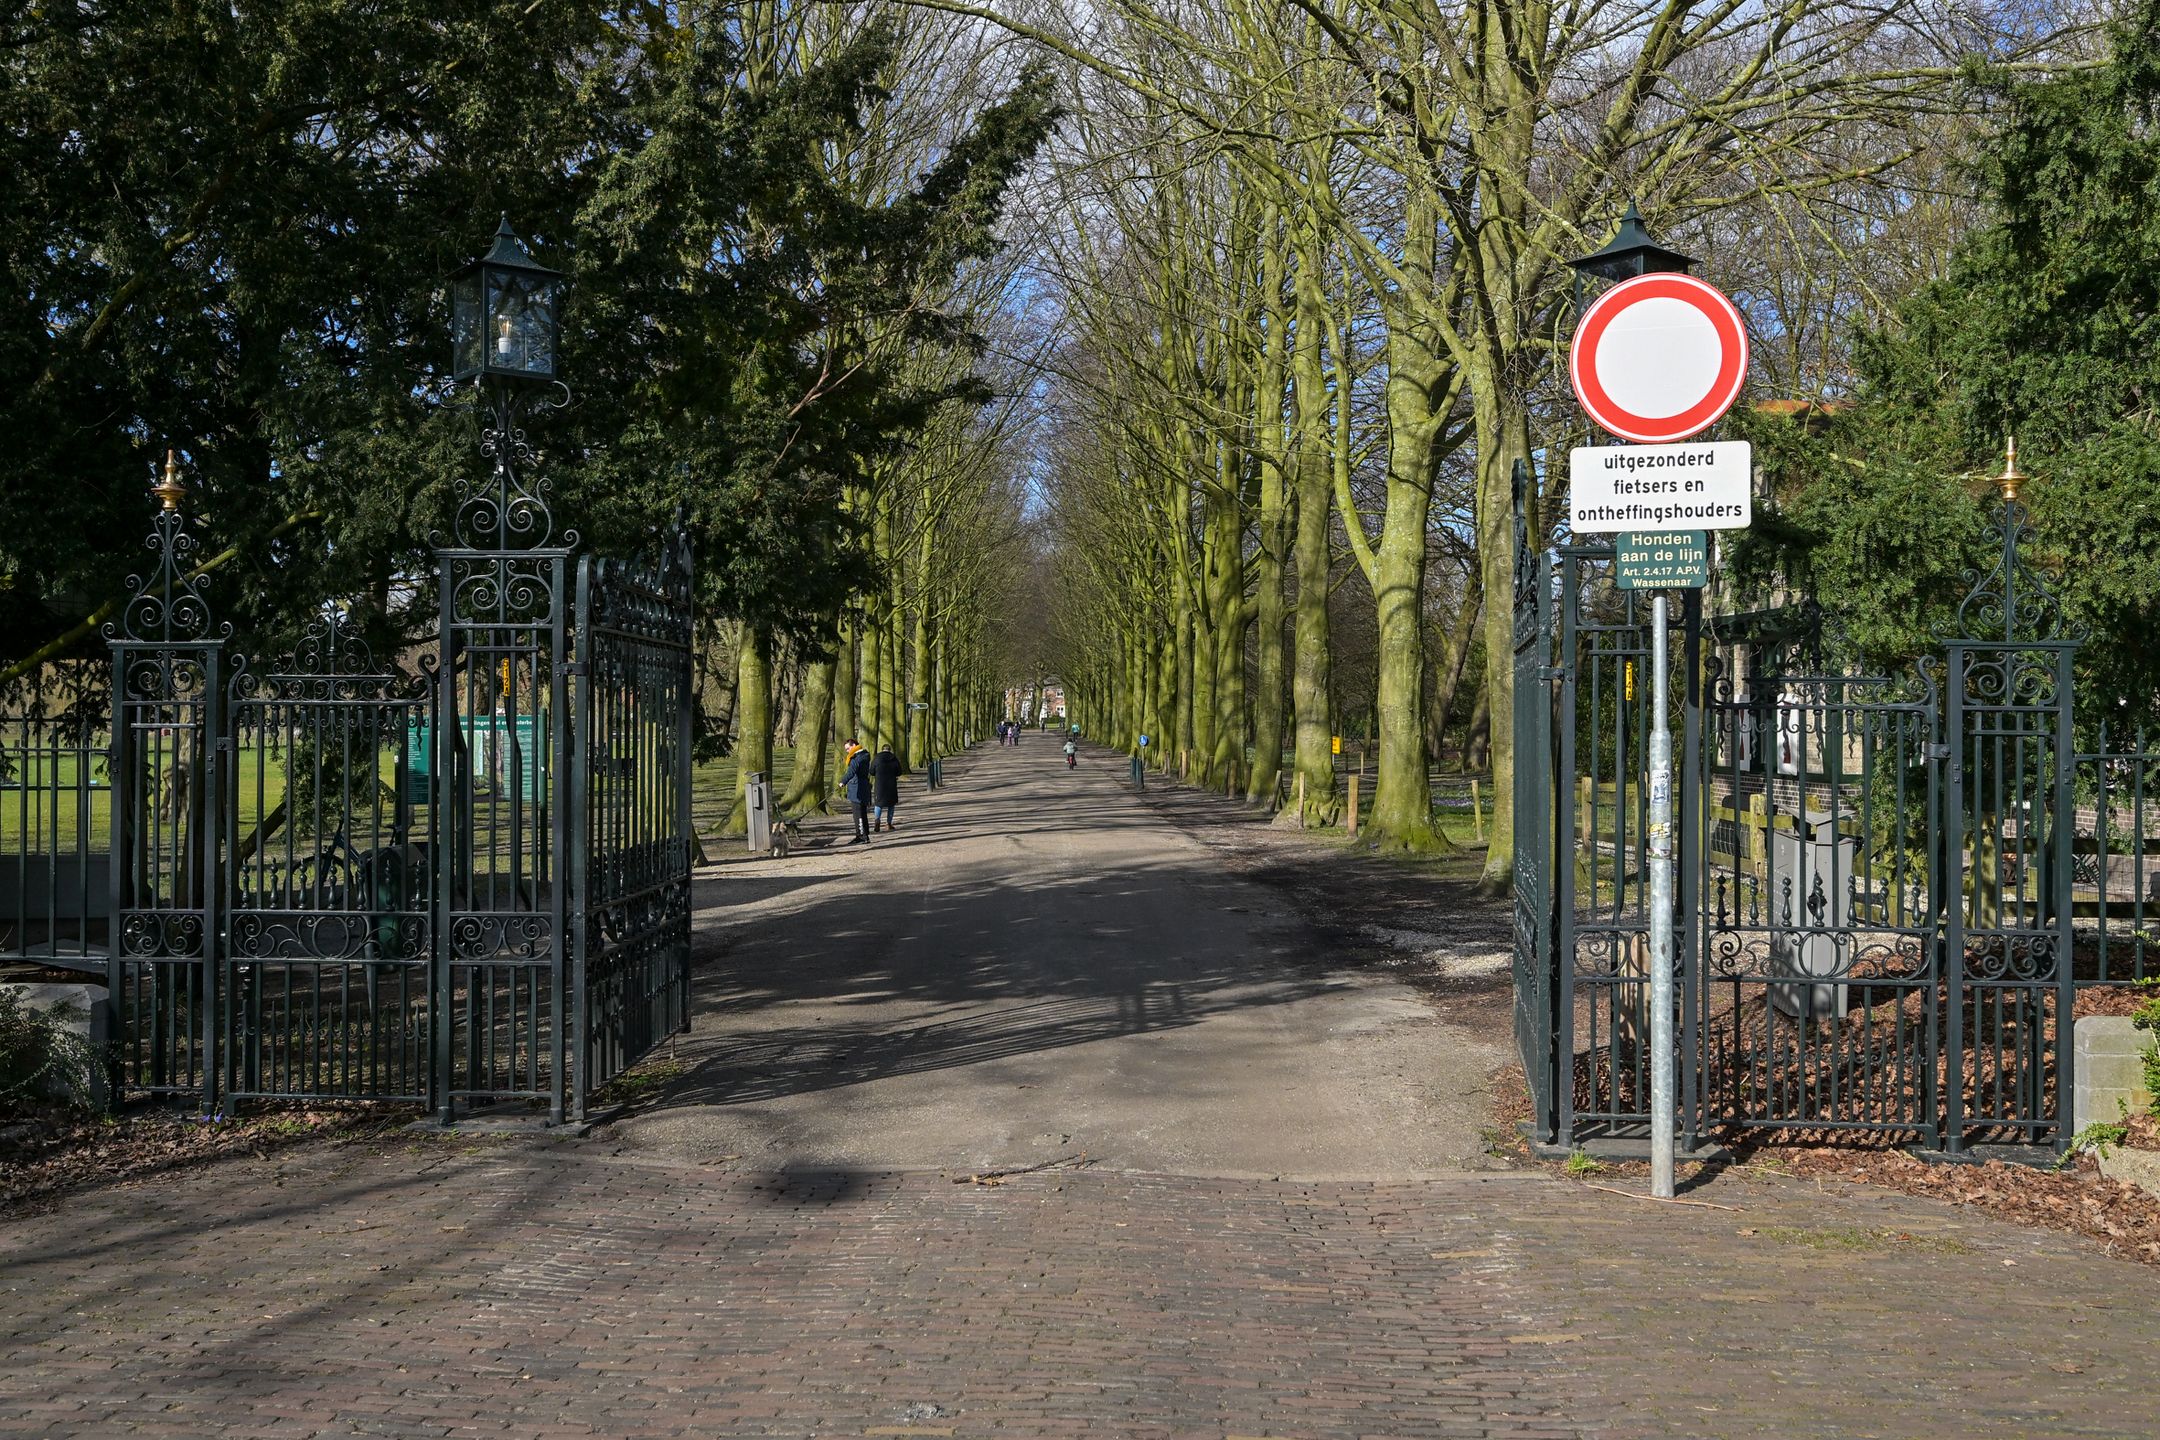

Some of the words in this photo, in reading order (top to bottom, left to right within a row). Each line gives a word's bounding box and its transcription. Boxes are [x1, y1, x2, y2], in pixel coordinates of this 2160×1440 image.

[1604, 450, 1714, 473] uitgezonderd
[1614, 479, 1677, 494] fietsers
[1684, 480, 1704, 492] en
[1578, 502, 1742, 523] ontheffingshouders
[1631, 533, 1692, 546] Honden
[1621, 552, 1648, 562] aan
[1654, 549, 1673, 561] de
[1679, 548, 1702, 563] lijn
[1623, 567, 1640, 576] Art.
[1643, 566, 1672, 576] 2.4.17
[1676, 565, 1701, 575] A.P.V.
[1632, 578, 1691, 587] Wassenaar
